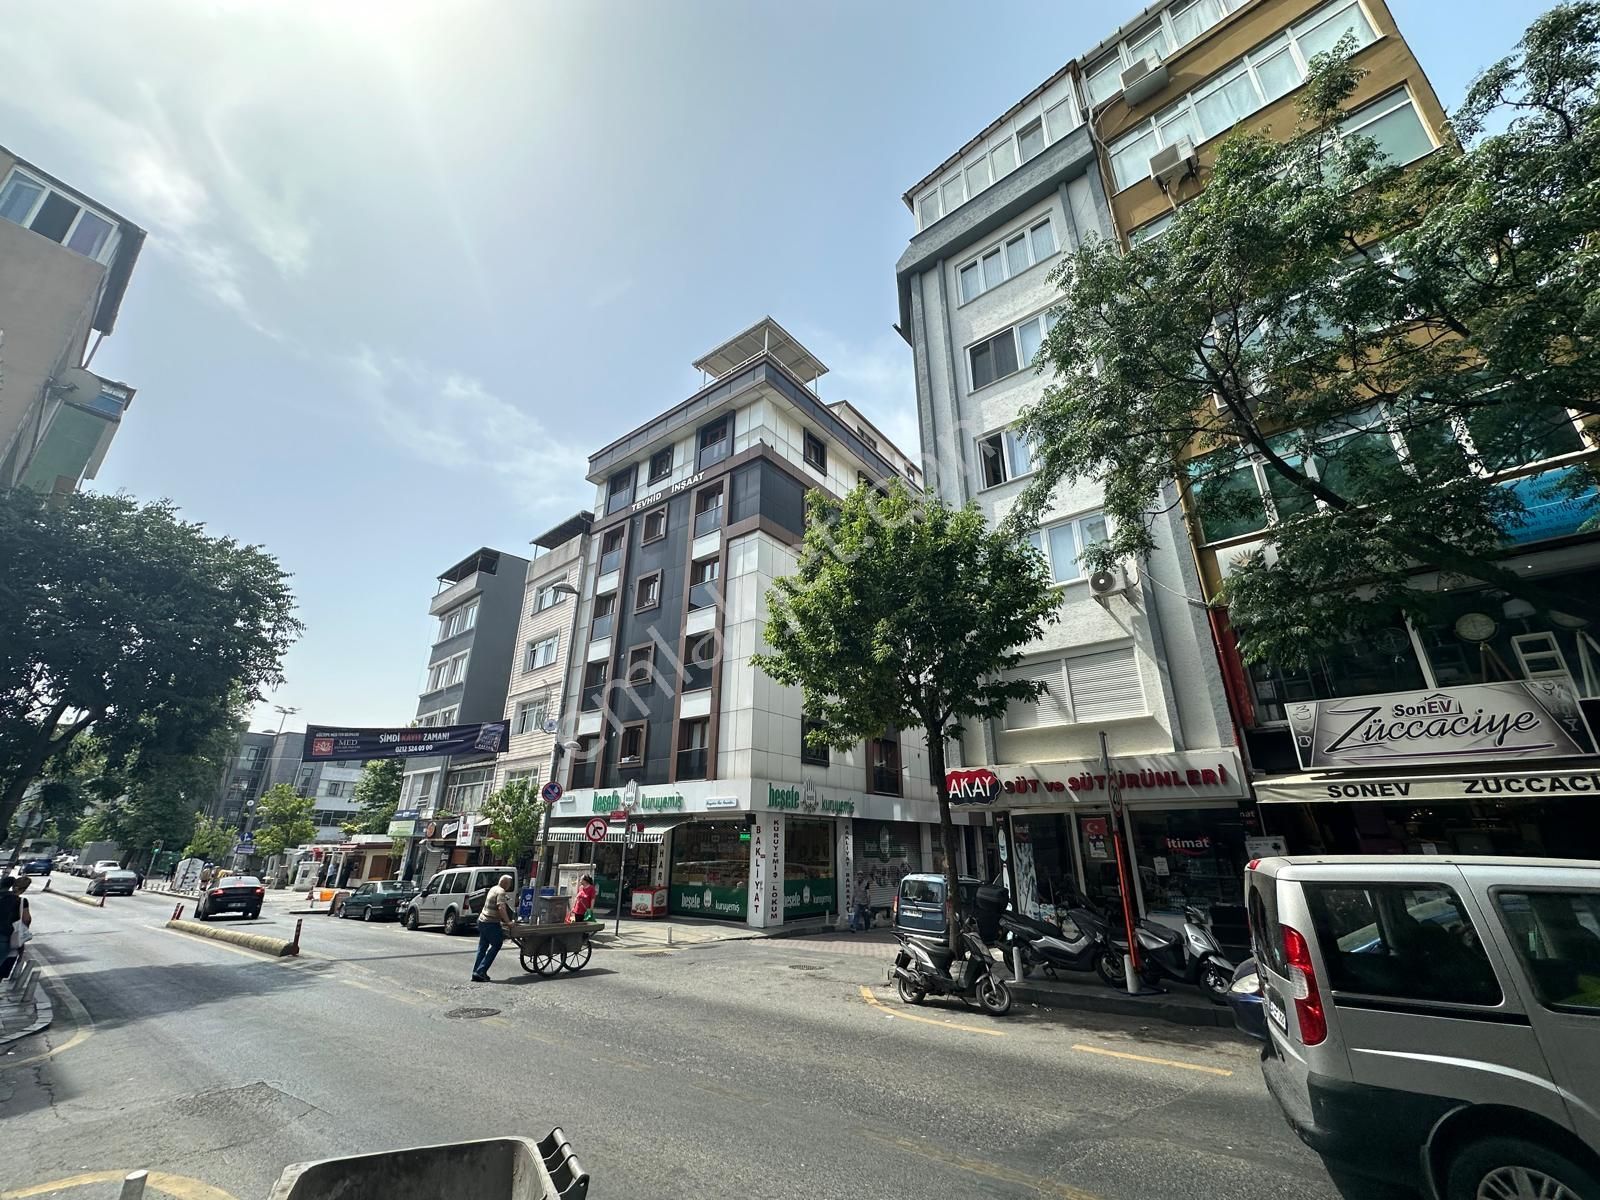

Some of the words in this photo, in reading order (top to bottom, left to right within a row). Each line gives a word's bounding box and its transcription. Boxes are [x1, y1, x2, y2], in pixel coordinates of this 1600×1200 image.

[631, 492, 662, 512] TEVHİD
[671, 471, 705, 494] İNŞAAT
[1394, 699, 1452, 717] SonEV
[379, 732, 400, 743] ŞİMDİ
[1324, 706, 1540, 754] Züccaciye
[948, 776, 991, 799] AKAY
[1003, 776, 1040, 794] SÜT
[1043, 781, 1065, 792] ve
[1068, 772, 1106, 791] SÜT
[1327, 782, 1410, 798] SONEV
[772, 820, 780, 878] KURUYEMİŞ
[1167, 838, 1210, 848] itimat
[754, 825, 762, 914] BAKLİYAT
[770, 885, 779, 919] LOKUM
